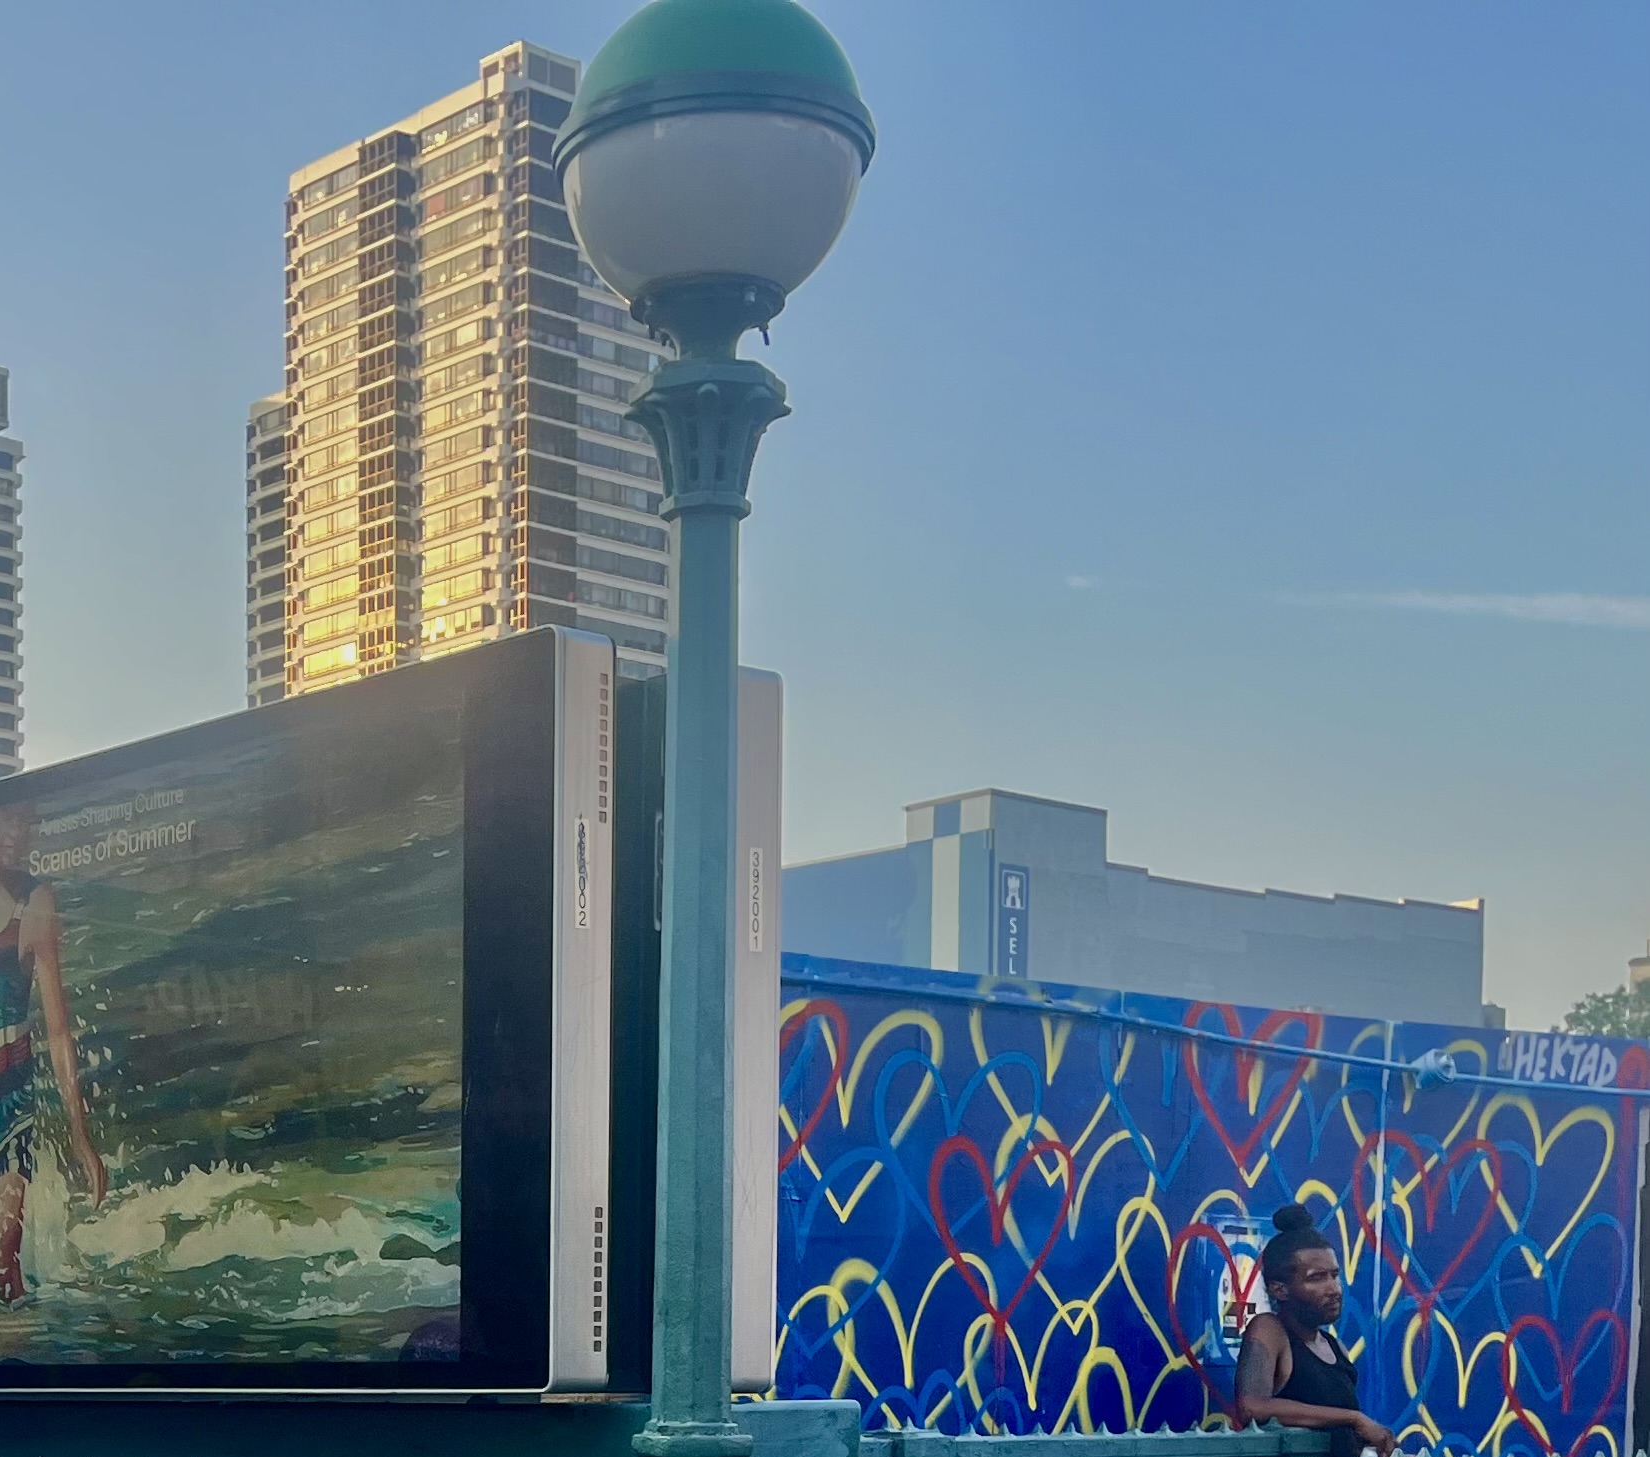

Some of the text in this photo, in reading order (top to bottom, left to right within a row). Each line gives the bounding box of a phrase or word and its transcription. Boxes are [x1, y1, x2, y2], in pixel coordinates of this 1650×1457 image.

[81, 801, 133, 827] Shaping
[135, 788, 184, 814] Culture
[29, 819, 196, 877] Scenes of Summer
[752, 851, 760, 950] 392001
[1009, 917, 1018, 975] SEL
[1513, 1033, 1617, 1087] HEKTAD
